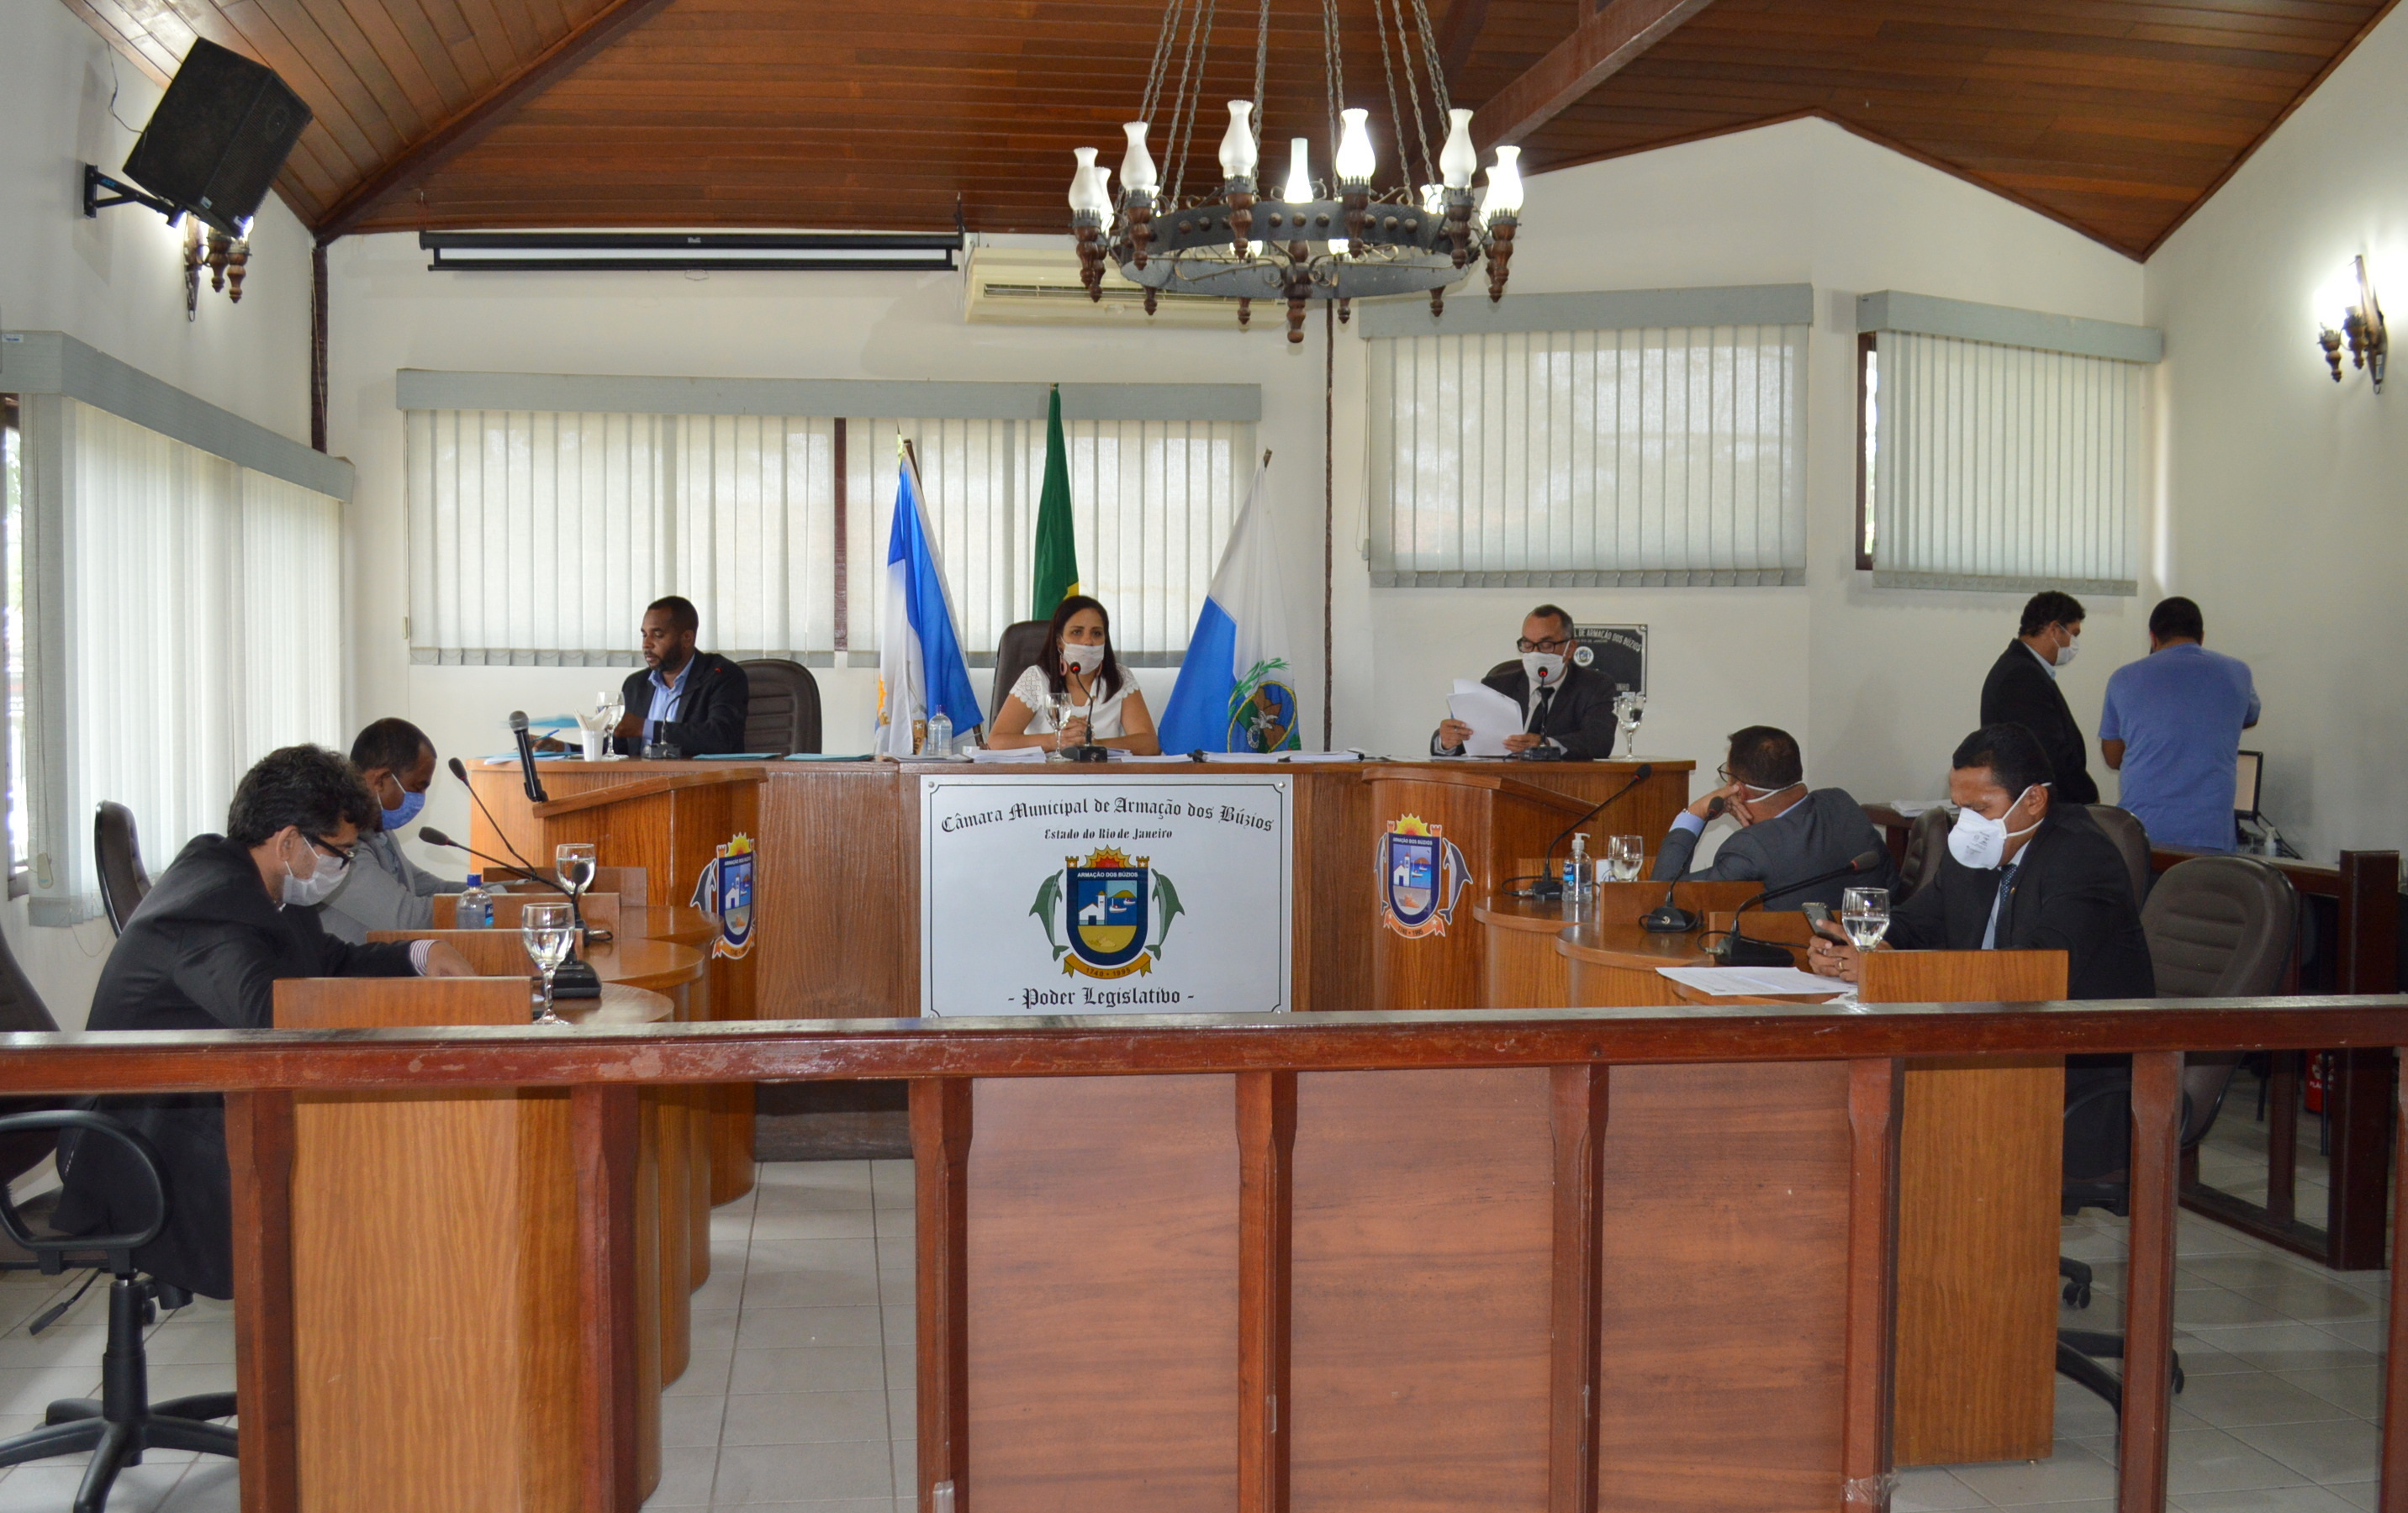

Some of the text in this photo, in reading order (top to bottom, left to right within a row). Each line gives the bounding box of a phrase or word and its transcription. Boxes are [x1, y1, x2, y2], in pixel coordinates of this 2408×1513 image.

[1587, 628, 1613, 640] ARMAÇÃO
[1612, 632, 1624, 644] DOS
[1623, 636, 1642, 652] BÚZIOS
[941, 797, 1274, 833] Câmara Municipal de Armação dos Búzios
[1044, 828, 1173, 841] Estado do Rio de Janeiro
[1086, 967, 1131, 977] 1740 1995
[1022, 988, 1075, 1010] Poder
[1081, 986, 1180, 1008] Legislativo
